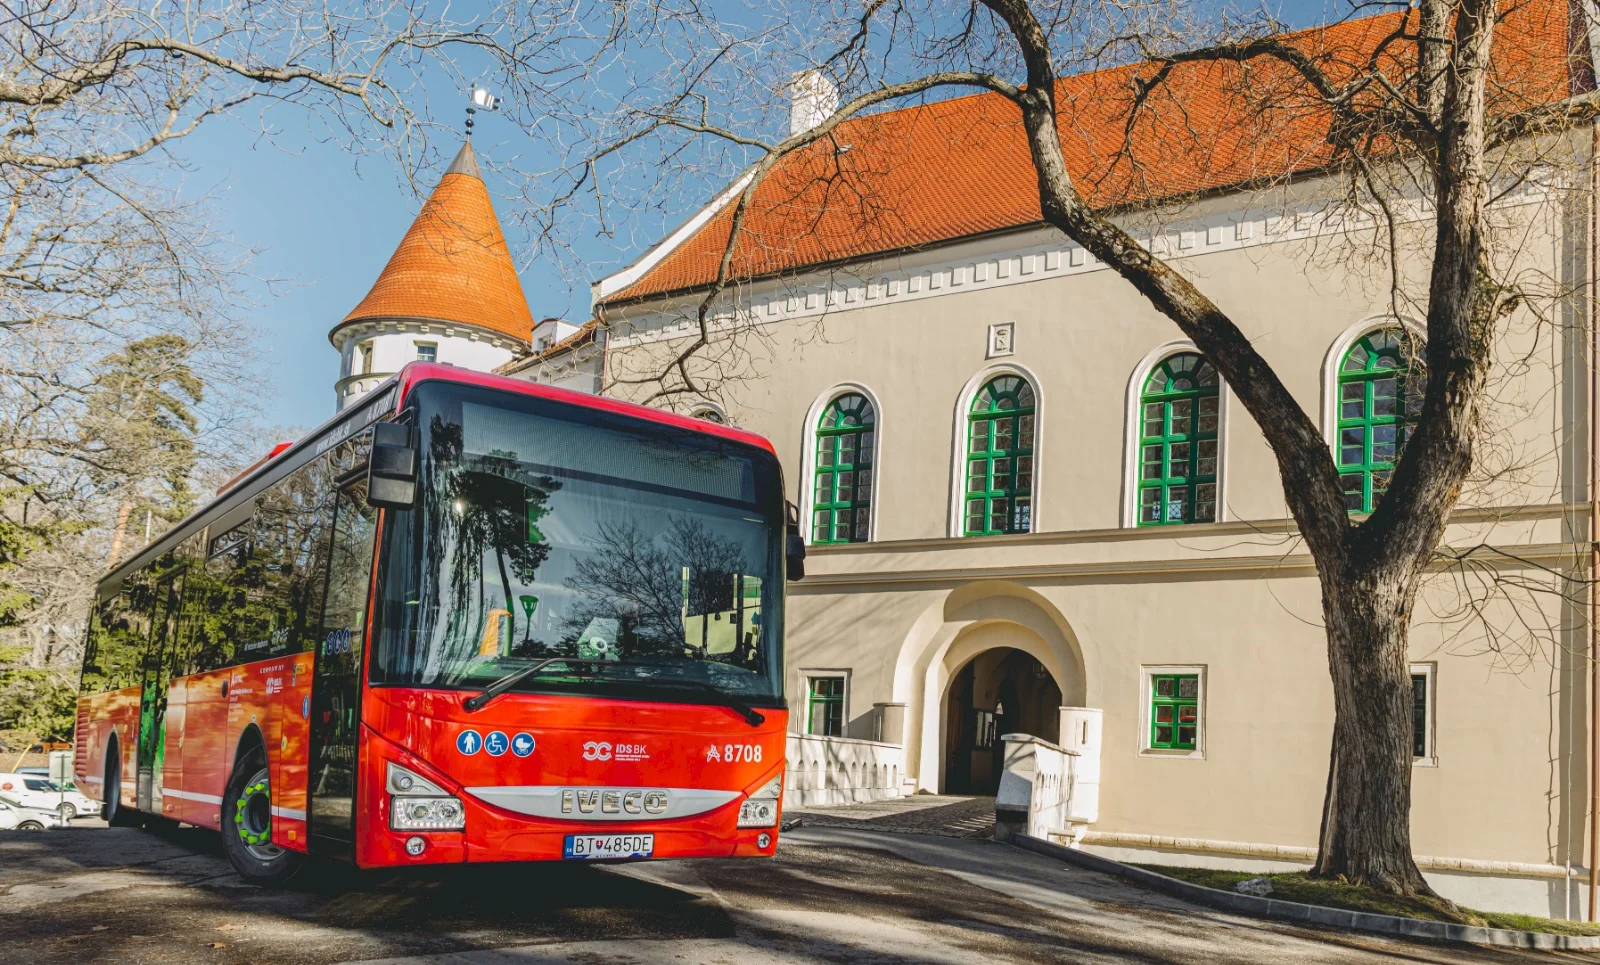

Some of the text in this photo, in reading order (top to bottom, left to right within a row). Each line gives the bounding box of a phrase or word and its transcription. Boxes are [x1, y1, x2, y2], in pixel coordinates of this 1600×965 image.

[616, 743, 647, 755] IDS BK
[724, 743, 763, 763] 8708
[561, 789, 668, 814] IVECO
[575, 836, 652, 854] BT 485DE
